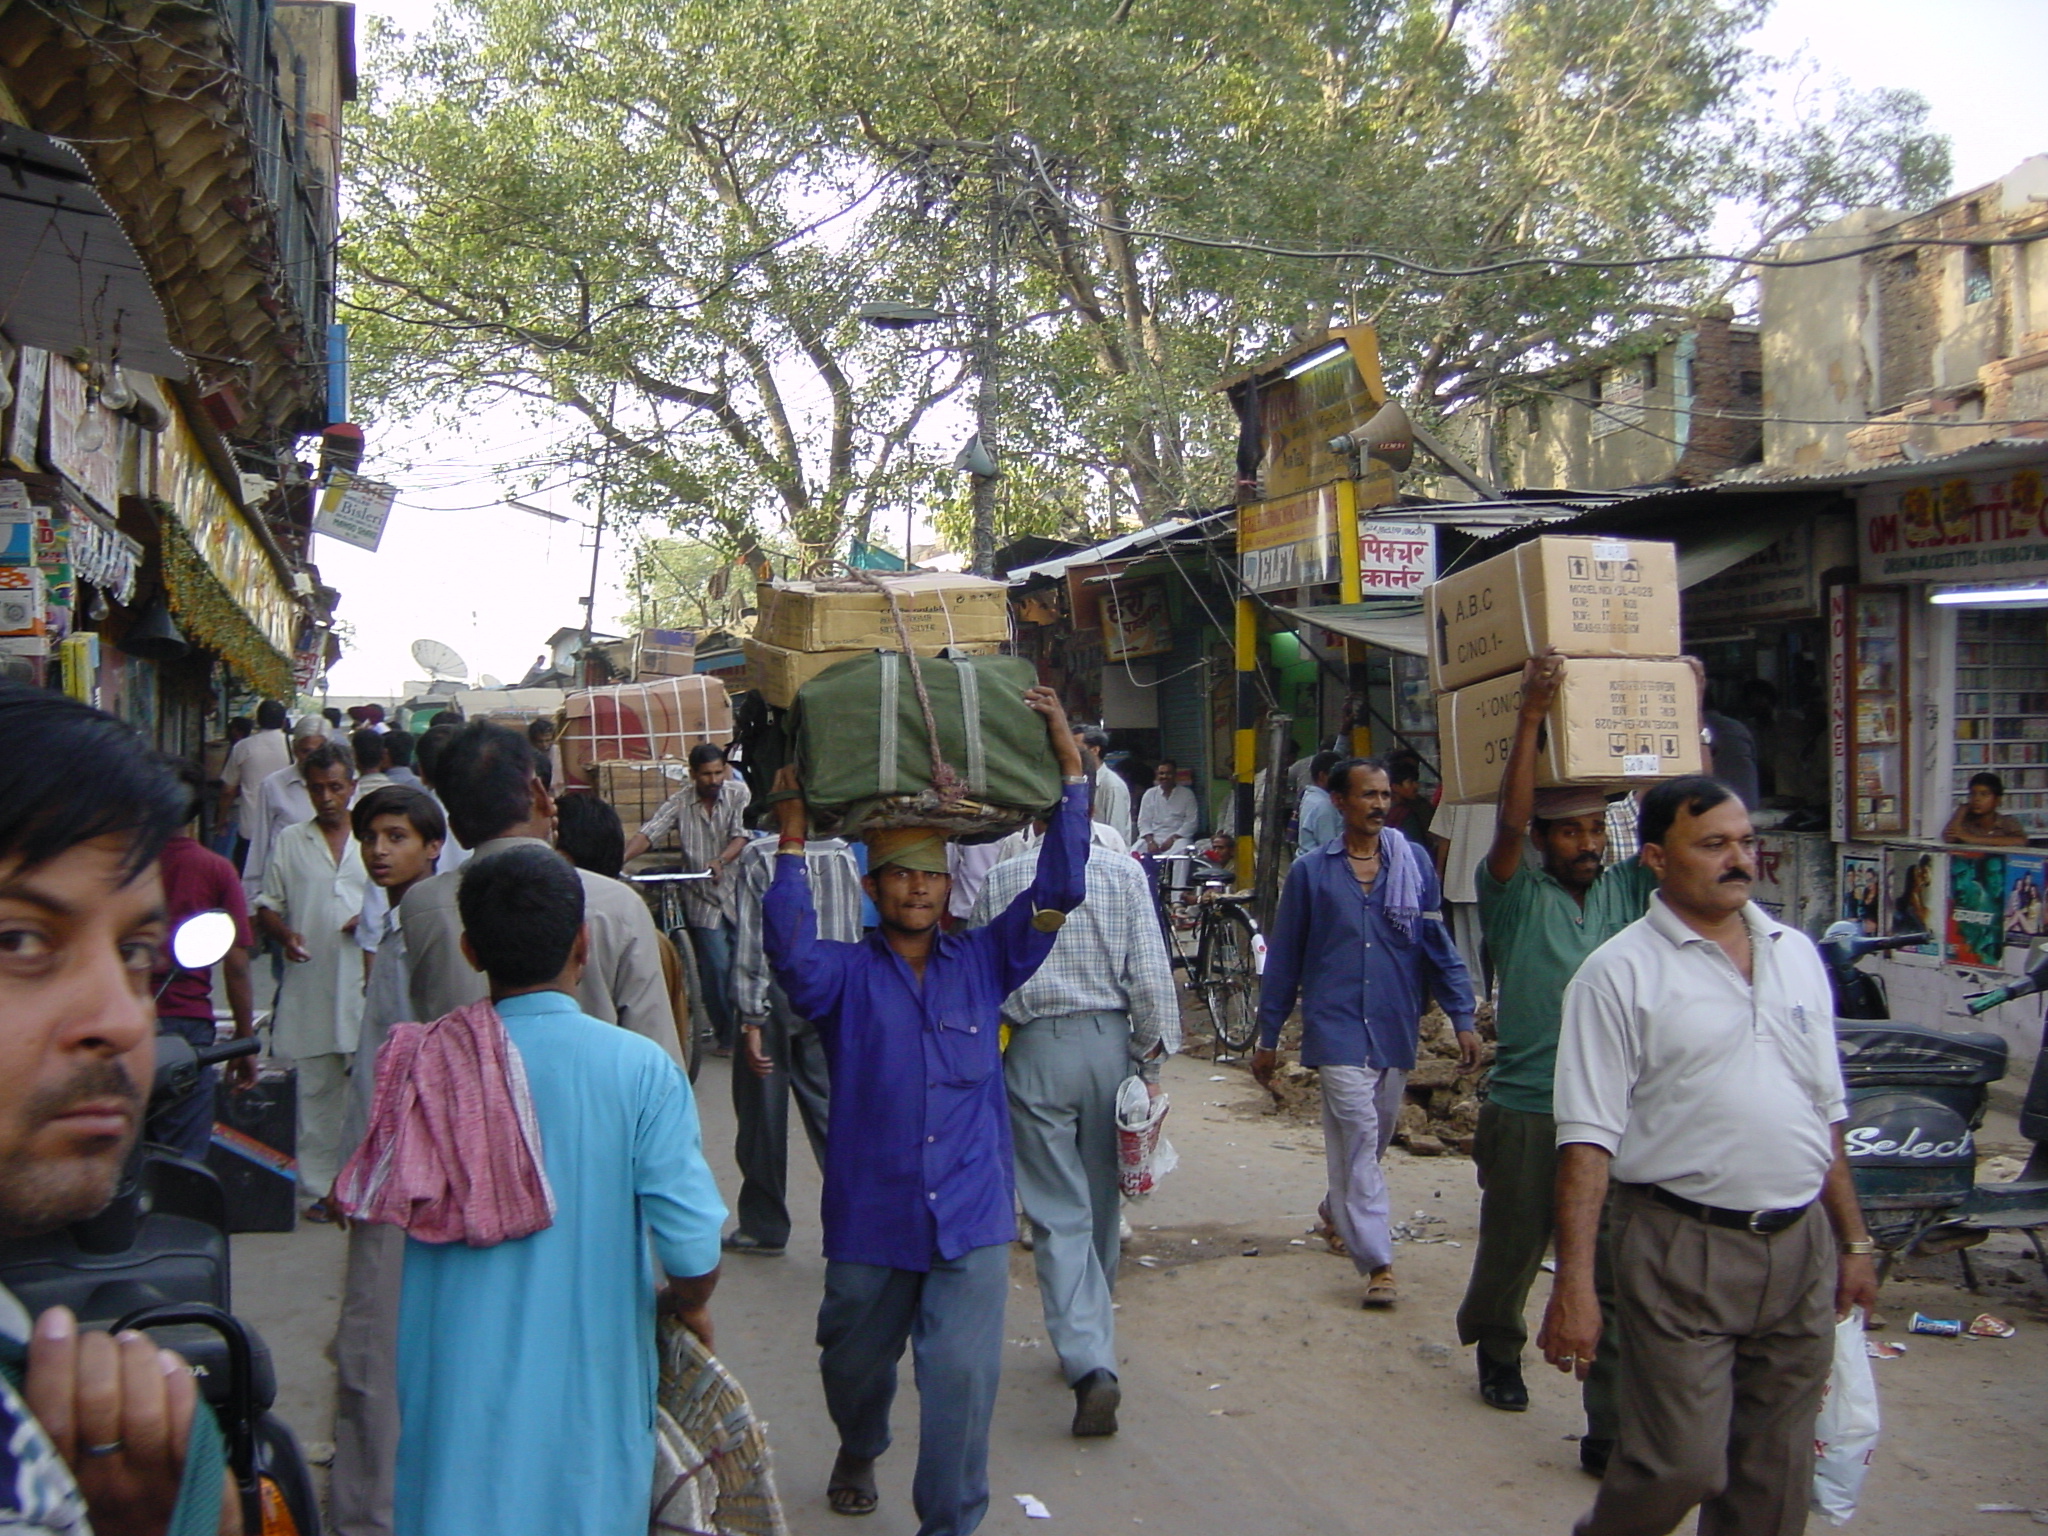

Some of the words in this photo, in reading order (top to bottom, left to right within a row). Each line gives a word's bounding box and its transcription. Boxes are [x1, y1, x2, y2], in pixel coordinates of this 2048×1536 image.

[341, 500, 384, 525] Bisleri
[1869, 513, 1898, 554] OM
[1456, 588, 1493, 623] A.B.C
[1832, 597, 1844, 638] NO
[1833, 653, 1845, 757] CHANGE
[1652, 720, 1680, 730] MODEL
[1844, 1126, 1972, 1158] Select
